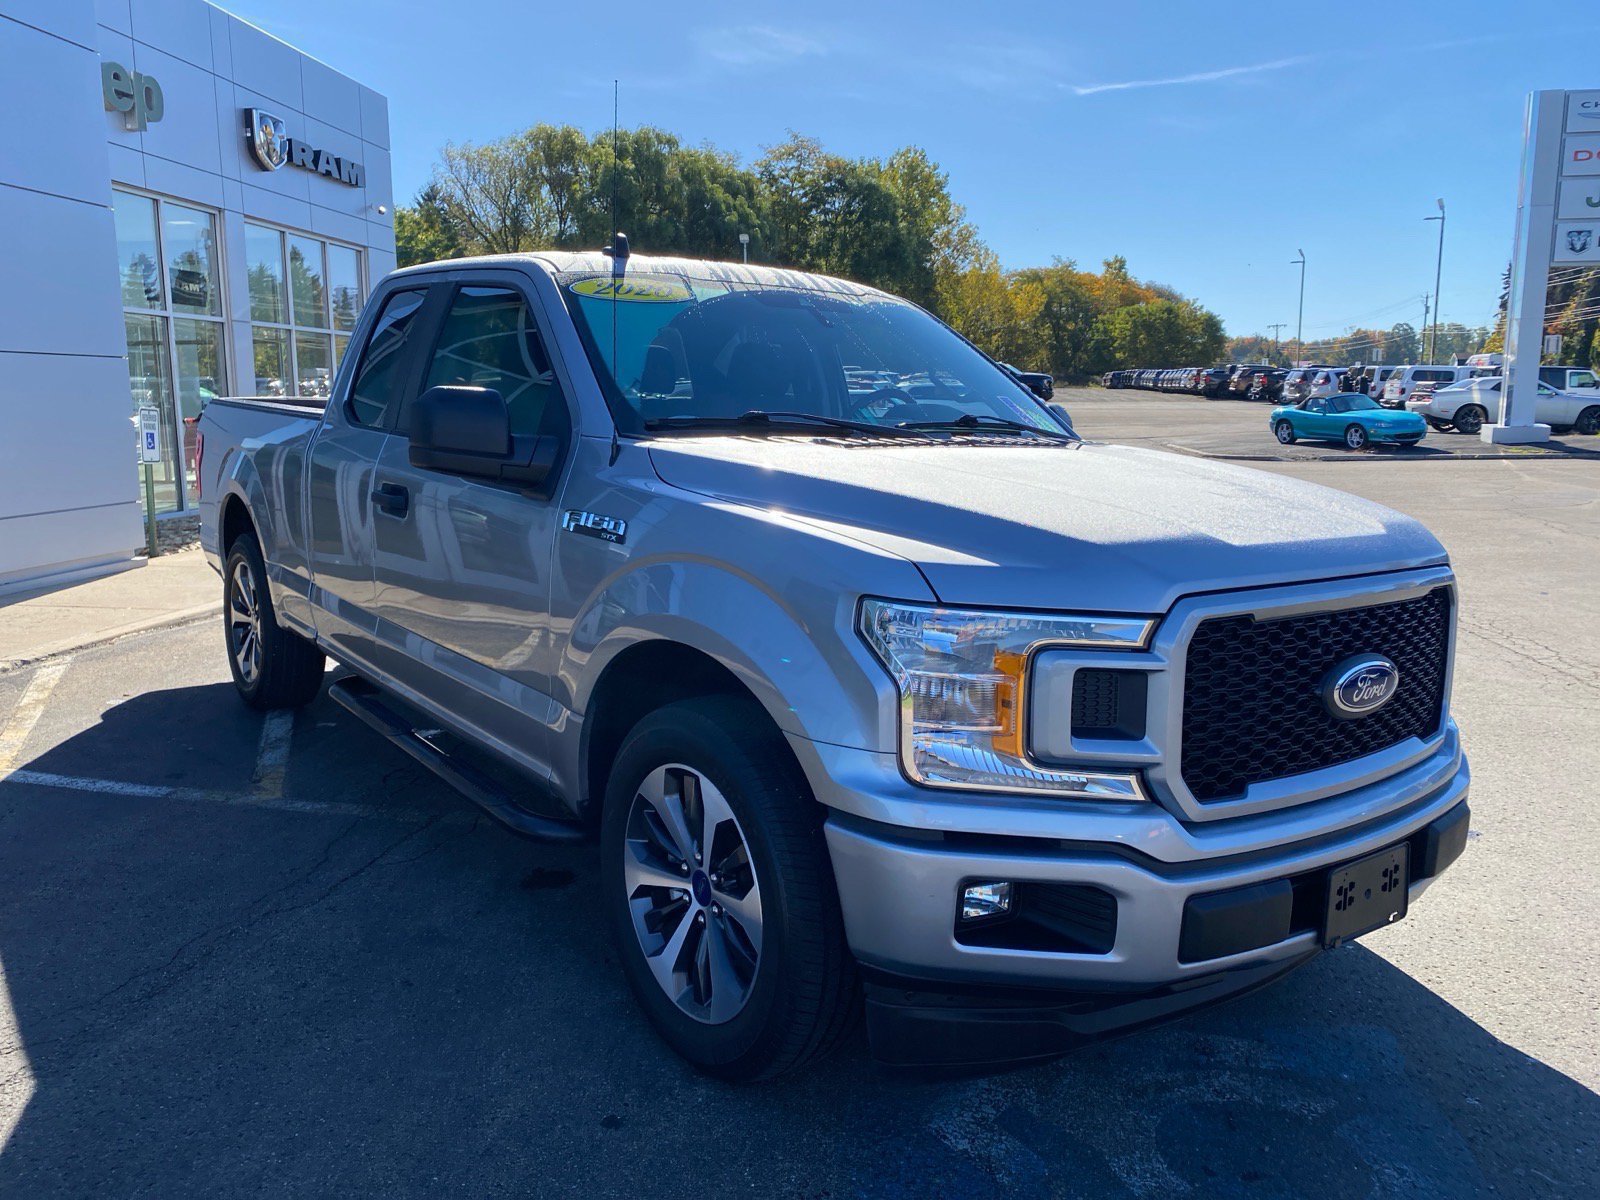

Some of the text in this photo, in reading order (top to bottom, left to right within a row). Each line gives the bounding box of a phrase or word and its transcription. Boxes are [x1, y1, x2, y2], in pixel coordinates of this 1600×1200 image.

[287, 138, 366, 188] RAM
[593, 279, 673, 297] 2020
[601, 533, 617, 542] STX
[1353, 673, 1388, 702] Ford
